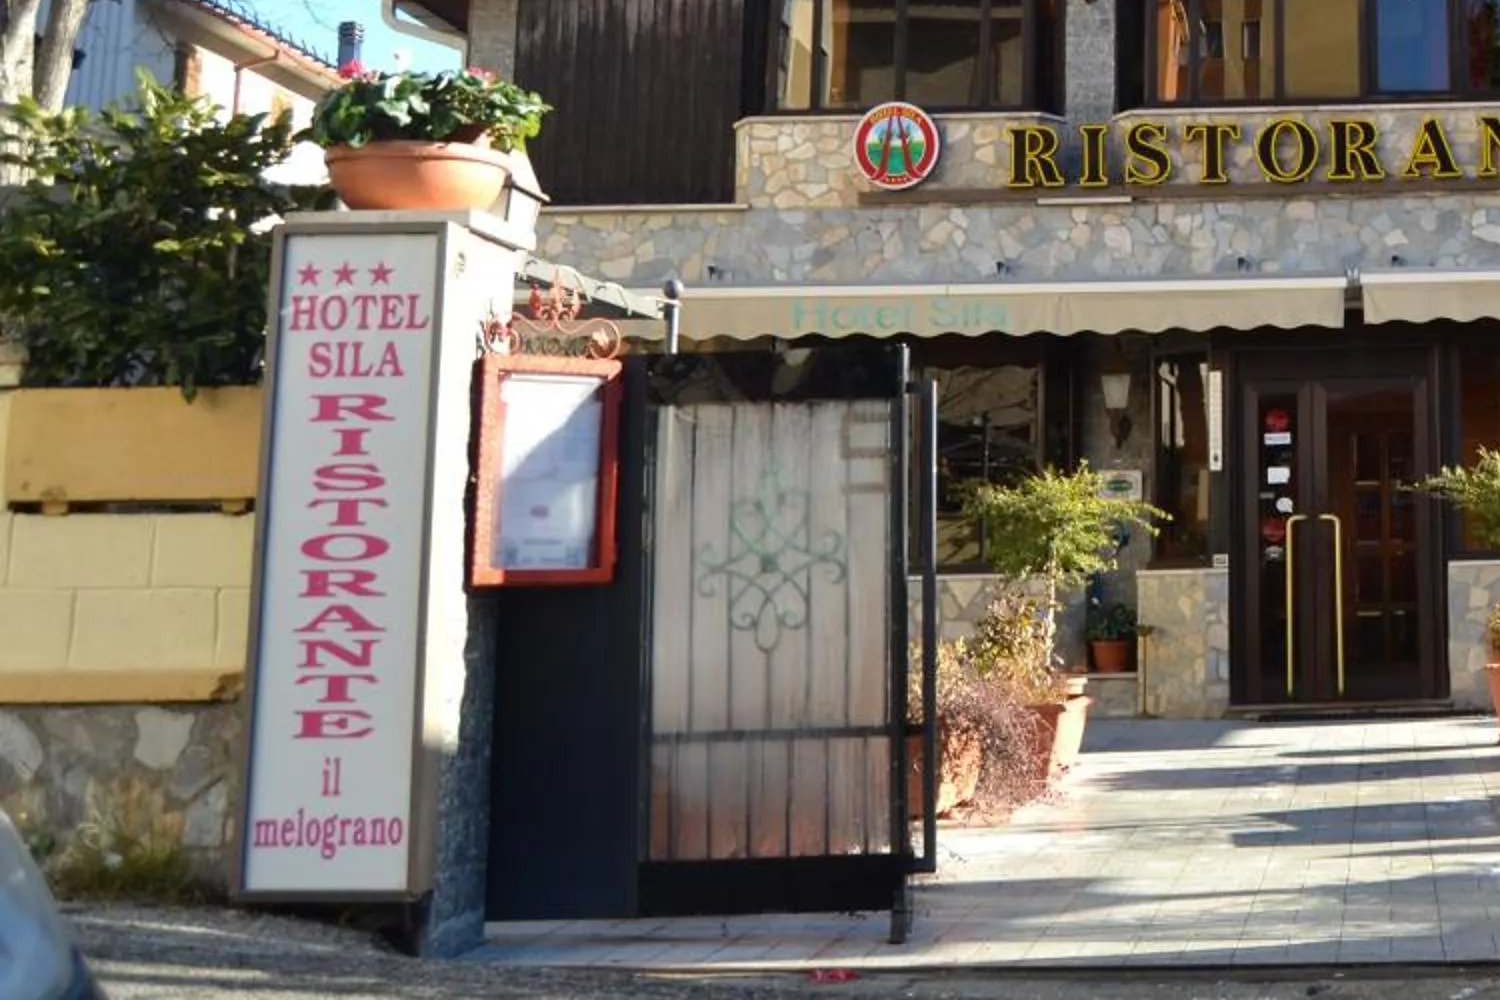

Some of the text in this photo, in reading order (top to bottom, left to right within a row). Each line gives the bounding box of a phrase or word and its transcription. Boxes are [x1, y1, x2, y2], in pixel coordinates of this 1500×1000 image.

[289, 293, 430, 332] HOTEL
[308, 340, 404, 379] SILA
[293, 392, 396, 740] RISTORANTE
[321, 757, 342, 797] il
[253, 808, 404, 860] melograno
